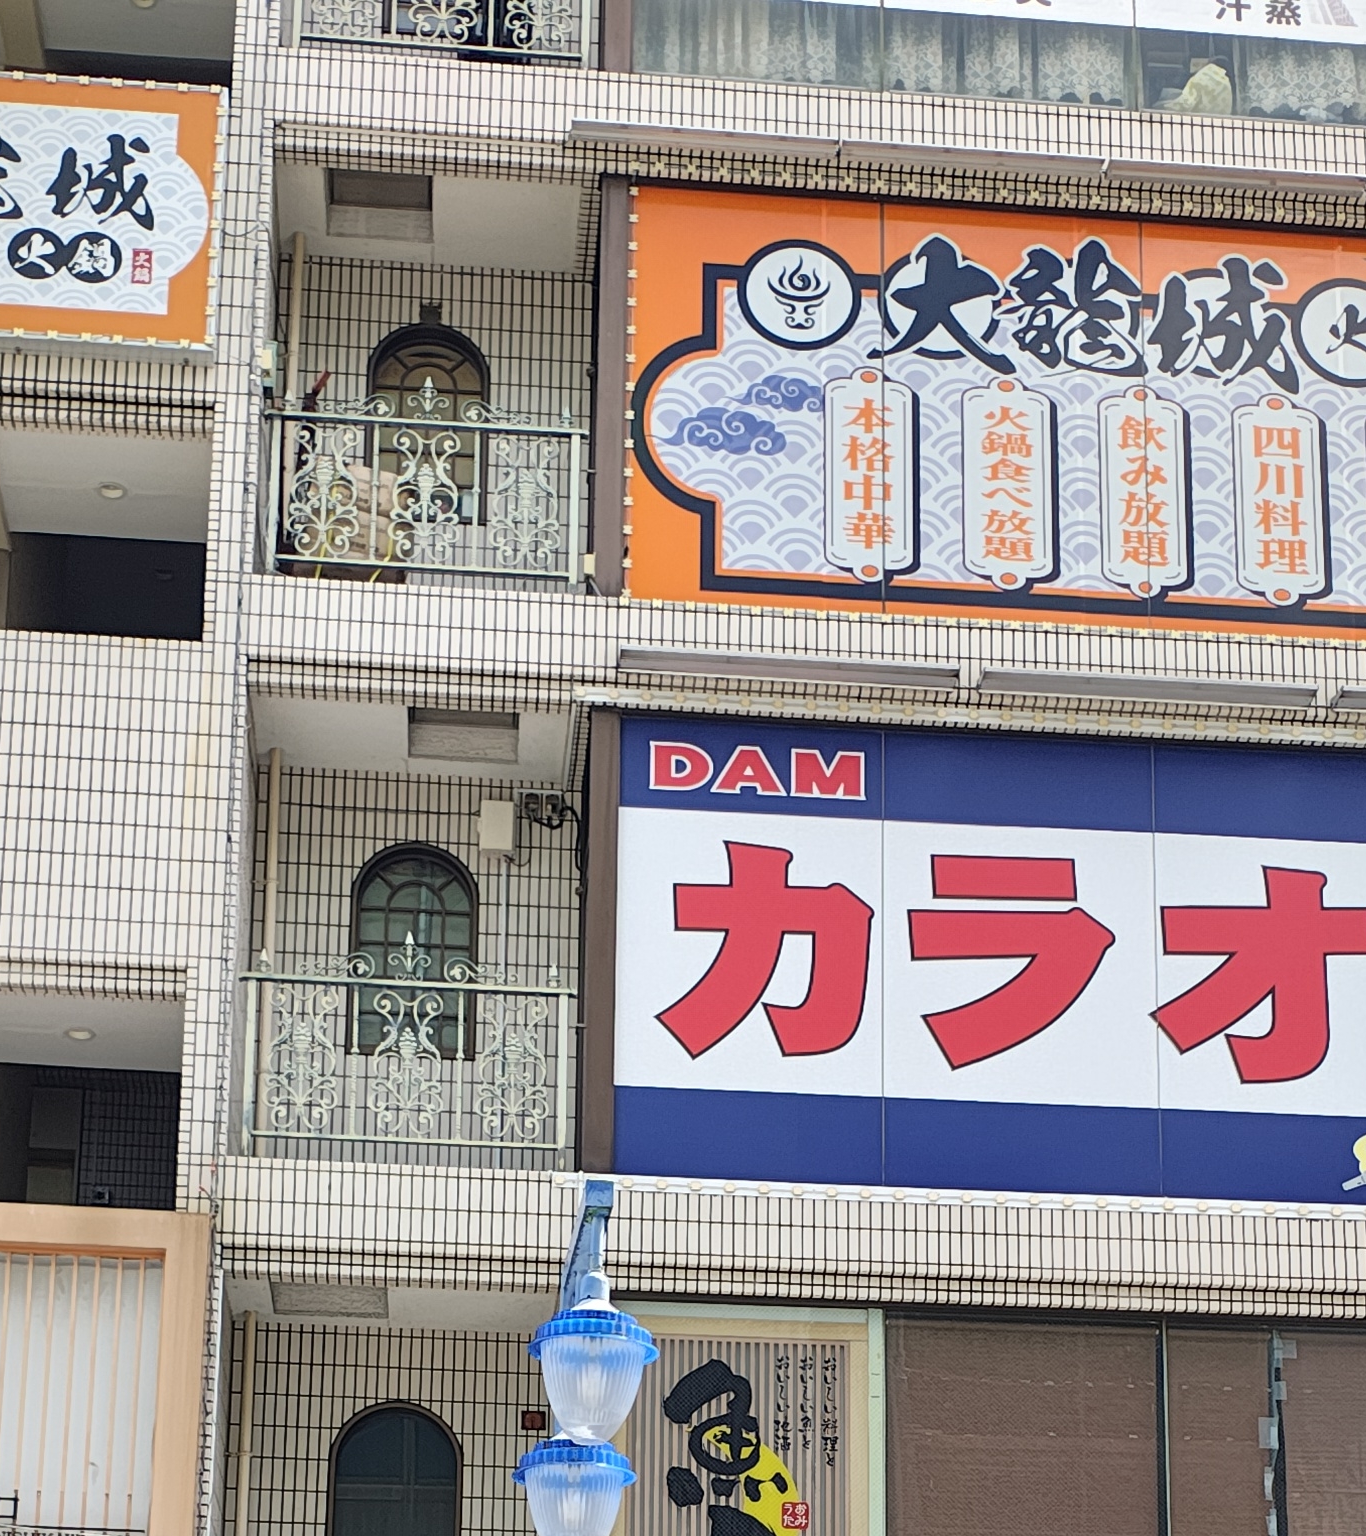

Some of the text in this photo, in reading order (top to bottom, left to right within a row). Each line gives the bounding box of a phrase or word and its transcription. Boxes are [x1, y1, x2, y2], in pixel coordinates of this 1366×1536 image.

[15, 232, 117, 277] 火鍋
[132, 250, 152, 283] 火鍋
[870, 233, 1299, 392] 大龍城
[842, 399, 895, 550] 本格中華
[982, 406, 1035, 564] 火鍋食べ放題
[1117, 415, 1169, 569] 飲み放題
[1252, 423, 1308, 577] 四川料理
[649, 740, 867, 801] DAM
[775, 1356, 792, 1451] おいしい地酒
[800, 1356, 815, 1451] おいしい魚と
[822, 1356, 839, 1467] おいしい料理と
